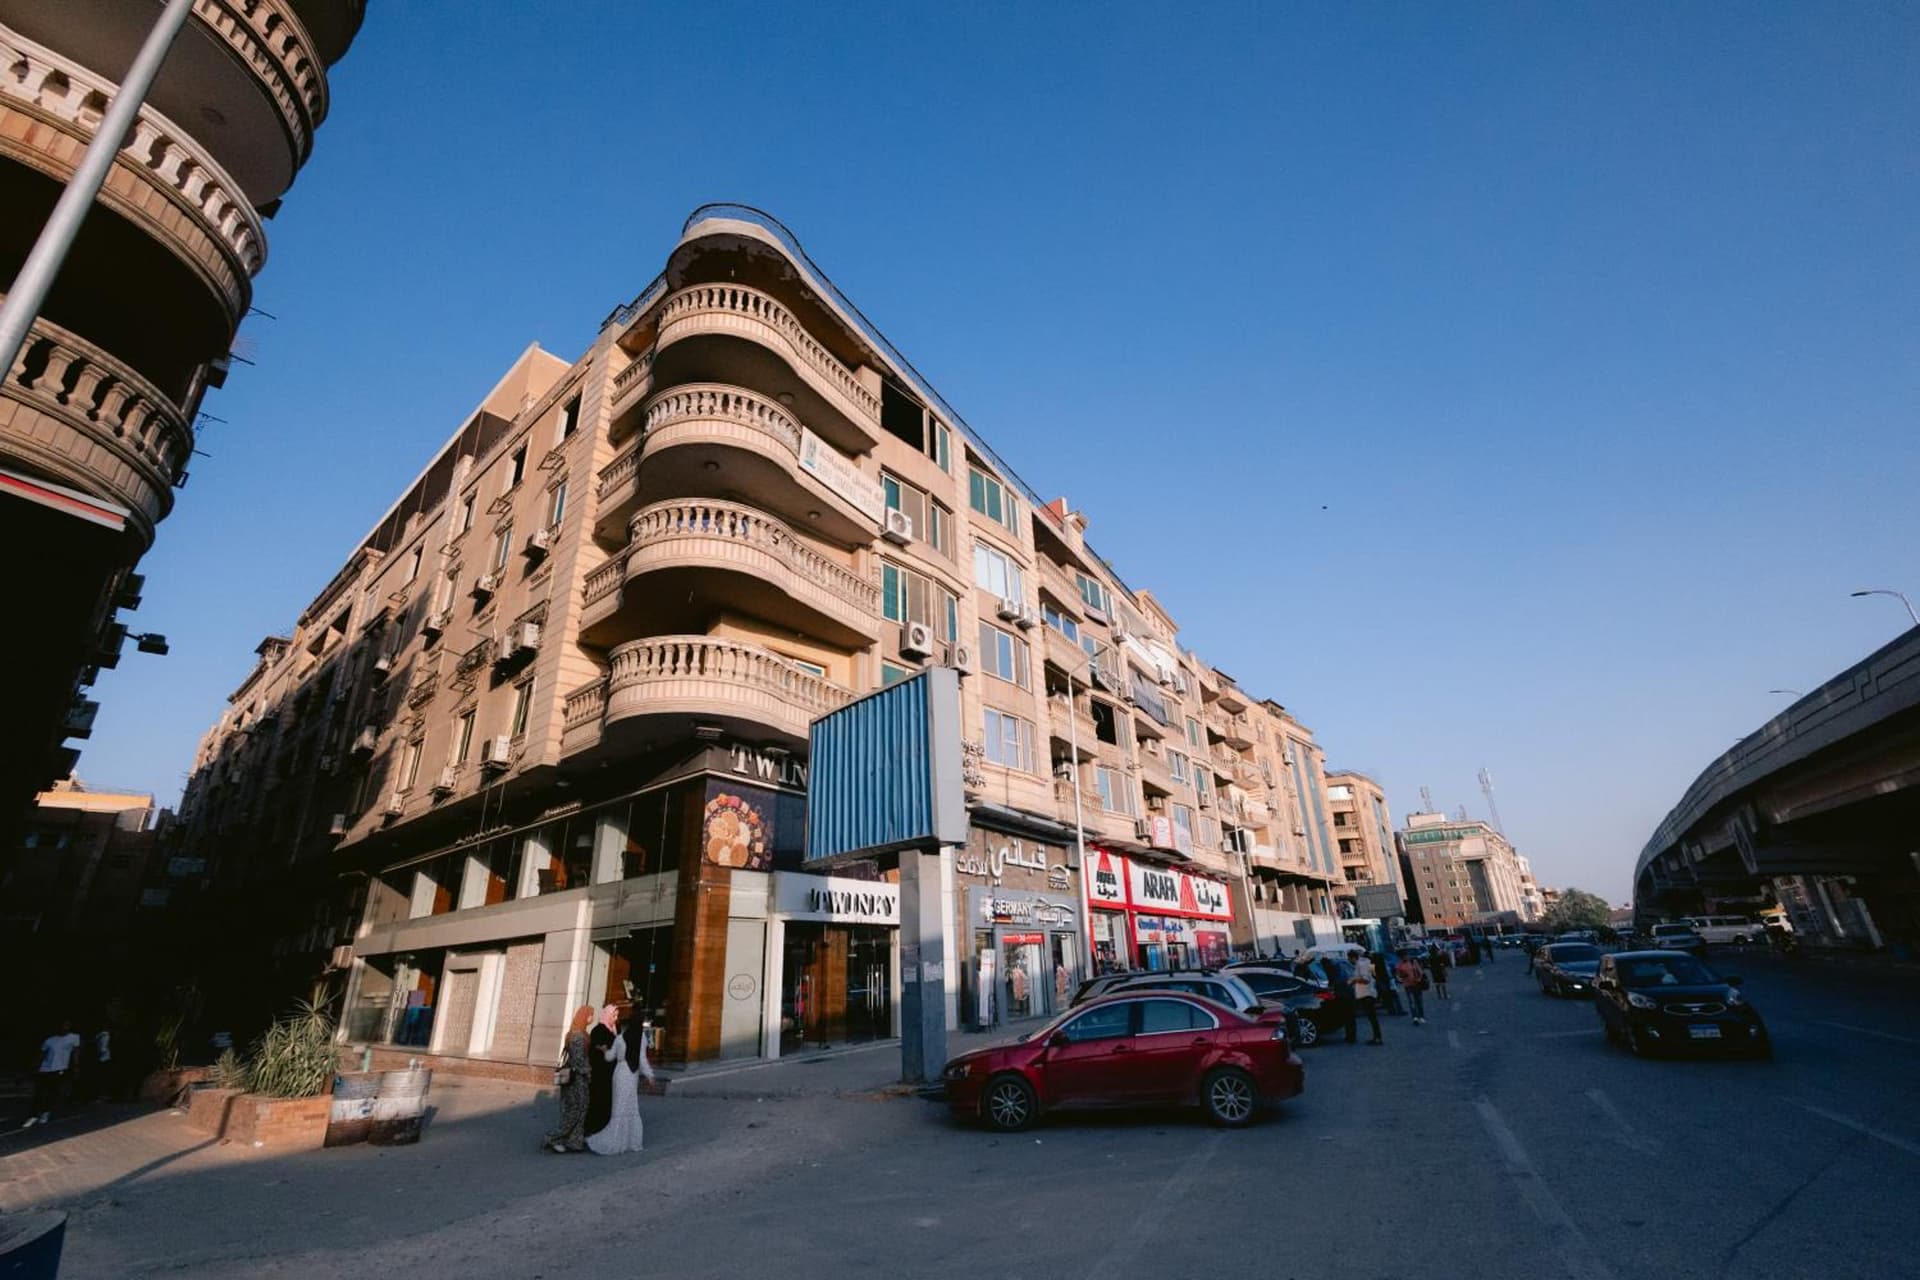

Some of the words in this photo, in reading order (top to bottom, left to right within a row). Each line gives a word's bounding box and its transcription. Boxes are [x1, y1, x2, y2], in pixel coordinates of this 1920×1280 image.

[731, 743, 808, 788] TWIN
[1144, 871, 1178, 902] ARAFA
[808, 888, 896, 916] TWINKY
[994, 899, 1032, 918] GERMANY
